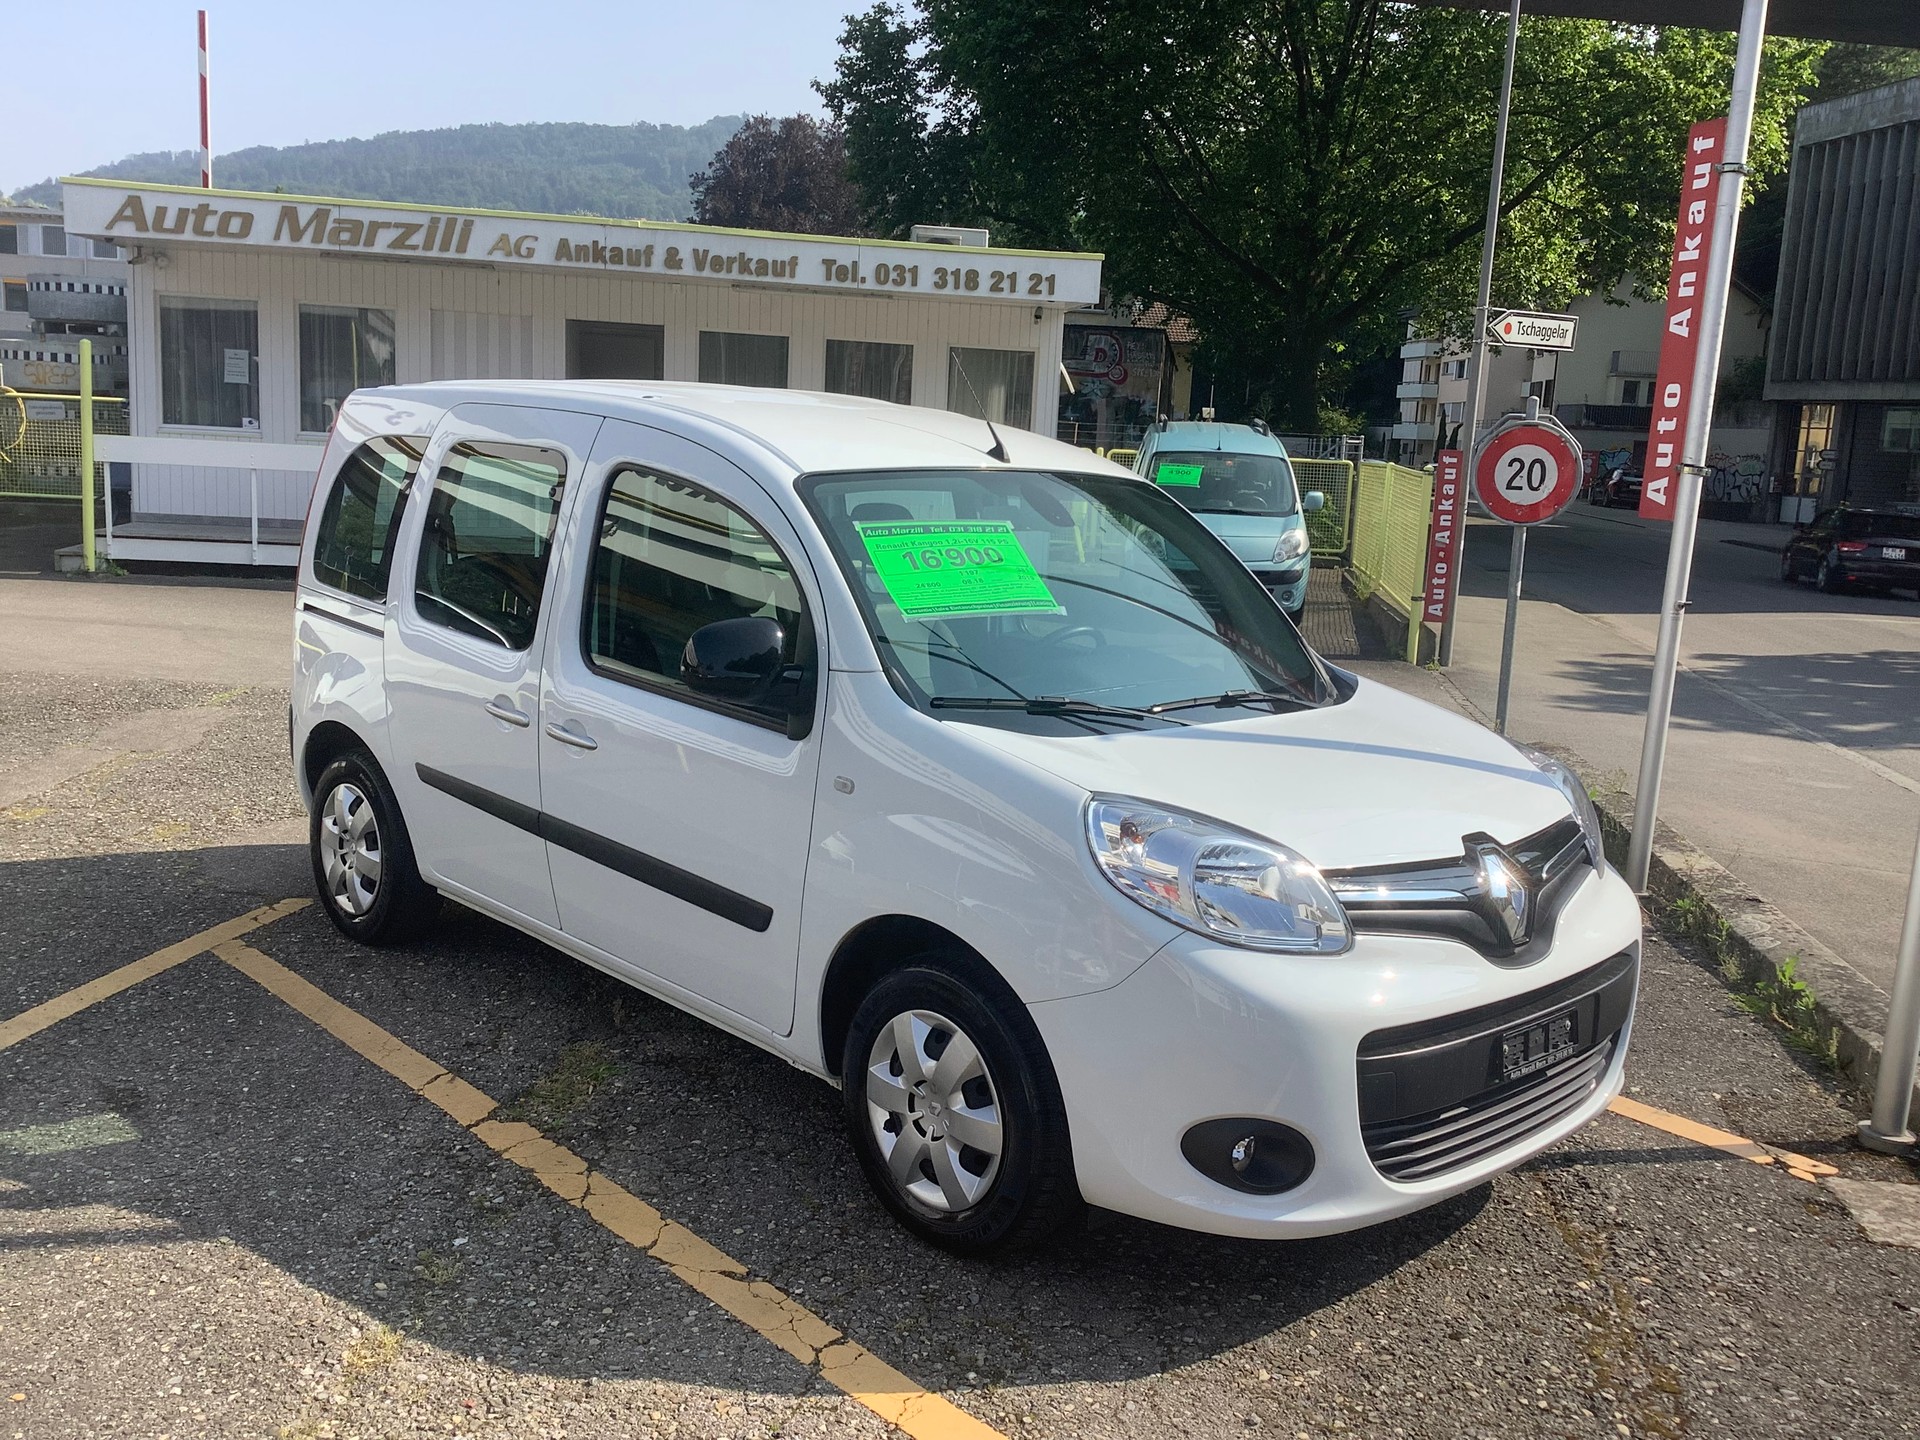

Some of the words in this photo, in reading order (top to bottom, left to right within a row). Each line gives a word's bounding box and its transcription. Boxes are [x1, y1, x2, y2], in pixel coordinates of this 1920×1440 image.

[104, 194, 255, 239] Auto
[273, 204, 476, 254] Marzili
[487, 233, 540, 259] AG
[554, 237, 655, 268] Ankauf
[663, 246, 684, 271] &
[692, 247, 800, 279] Verkauf
[822, 258, 867, 284] Tel.
[874, 262, 919, 288] 031
[933, 266, 980, 292] 318
[989, 270, 1018, 294] 21
[1028, 273, 1057, 296] 21
[1517, 320, 1570, 342] Tschaggelar
[1646, 382, 1682, 506] Auto
[1667, 134, 1716, 339] Ankauf
[1505, 457, 1547, 492] 20
[1434, 455, 1458, 545] Ankauf
[866, 529, 889, 537] Auto
[891, 526, 924, 536] Marzili
[875, 541, 909, 551] Renault
[910, 540, 943, 549] Kangoo
[901, 546, 1005, 571] 16'900
[1427, 562, 1448, 618] Auto
